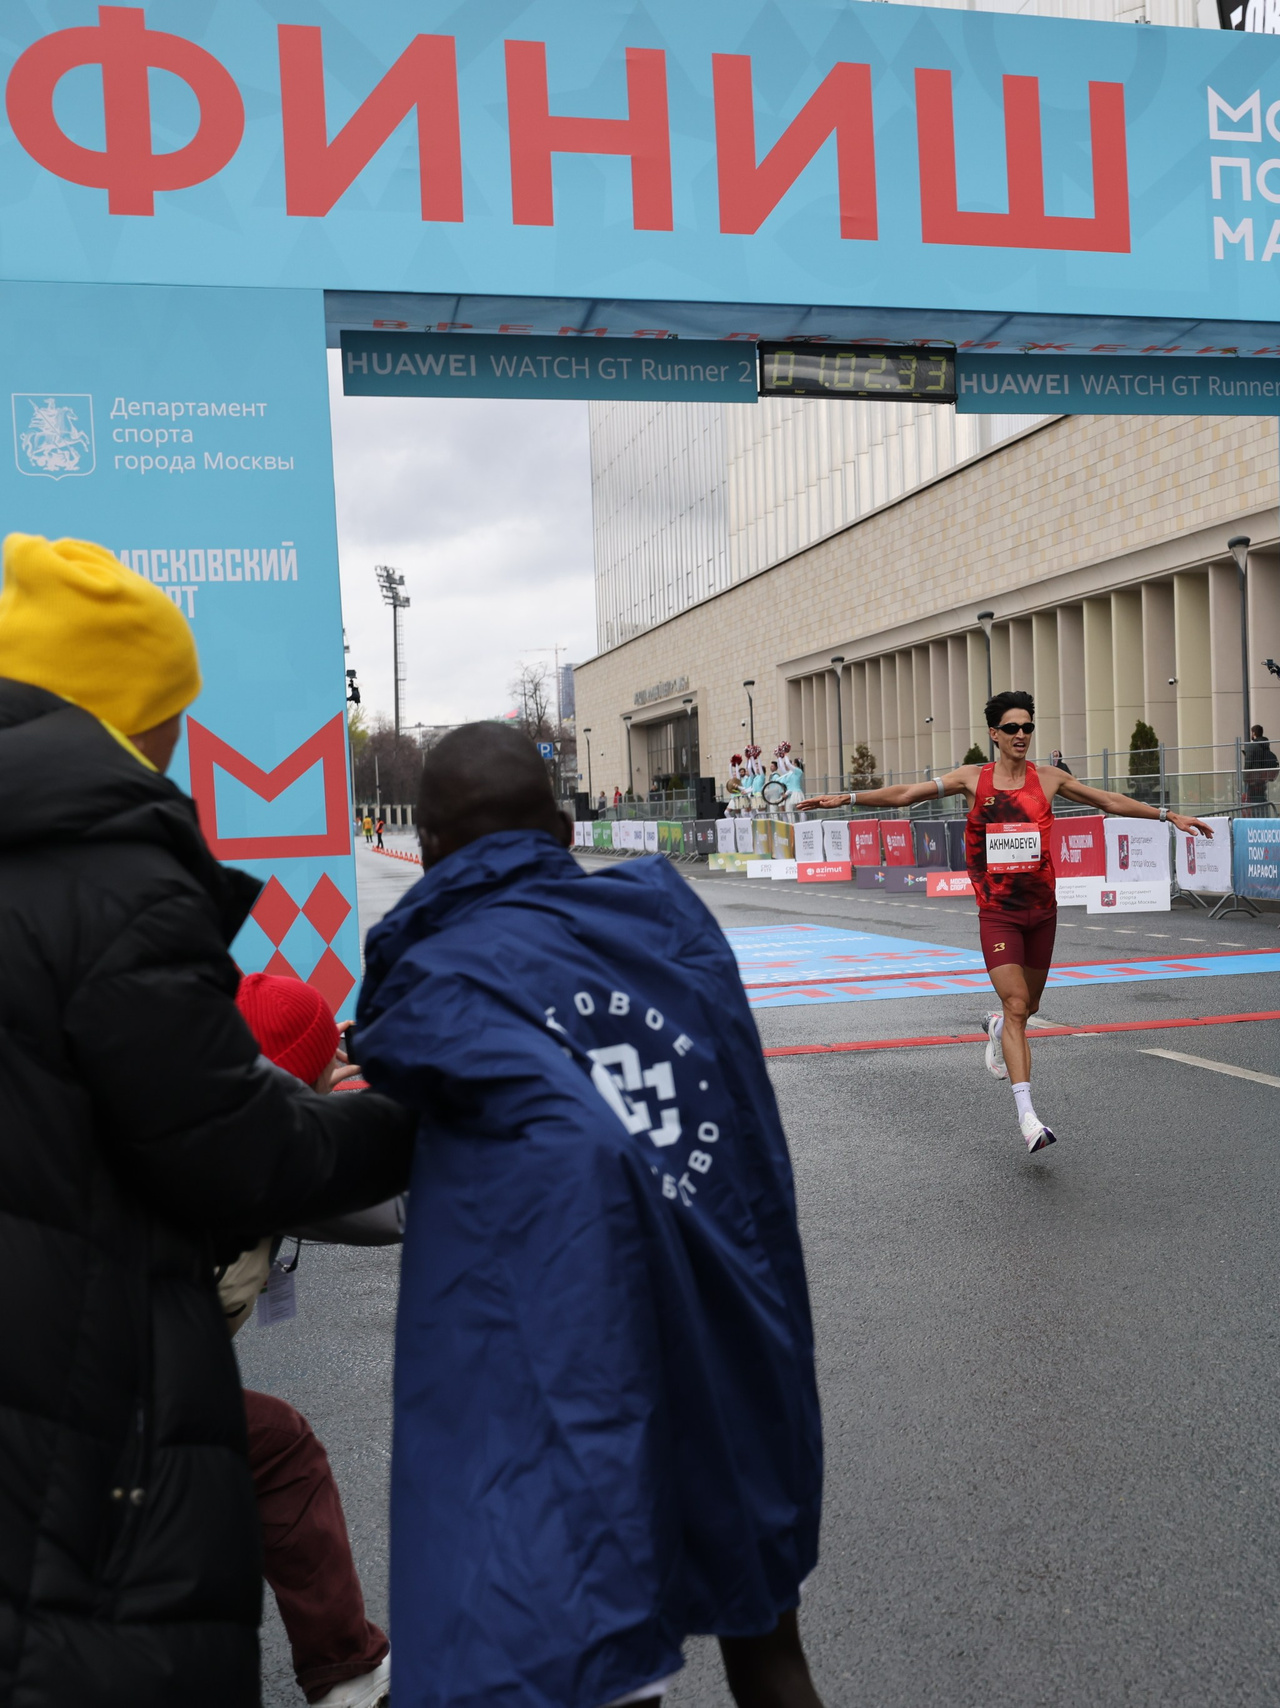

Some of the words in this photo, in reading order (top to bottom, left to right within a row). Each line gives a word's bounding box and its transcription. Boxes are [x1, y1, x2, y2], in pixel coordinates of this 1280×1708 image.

[5, 5, 1131, 254] ФИНИШ
[373, 319, 670, 340] ВРЕМЯ
[346, 352, 476, 377] HUAWEI
[490, 355, 590, 379] WATCH
[598, 357, 633, 381] GT
[641, 359, 728, 382] Runner
[738, 361, 752, 383] 2
[960, 372, 1070, 395] HUAWEI
[1081, 374, 1166, 396] WATCH
[1171, 375, 1202, 396] GT
[110, 397, 267, 421] Департамент
[112, 427, 194, 448] спорта
[114, 454, 196, 474] города
[203, 452, 295, 471] Москвы
[989, 837, 1037, 850] AKHMADEYEV
[1248, 847, 1265, 860] ПОЛУ
[816, 866, 842, 874] azimut
[1248, 864, 1278, 879] МАРАФОН
